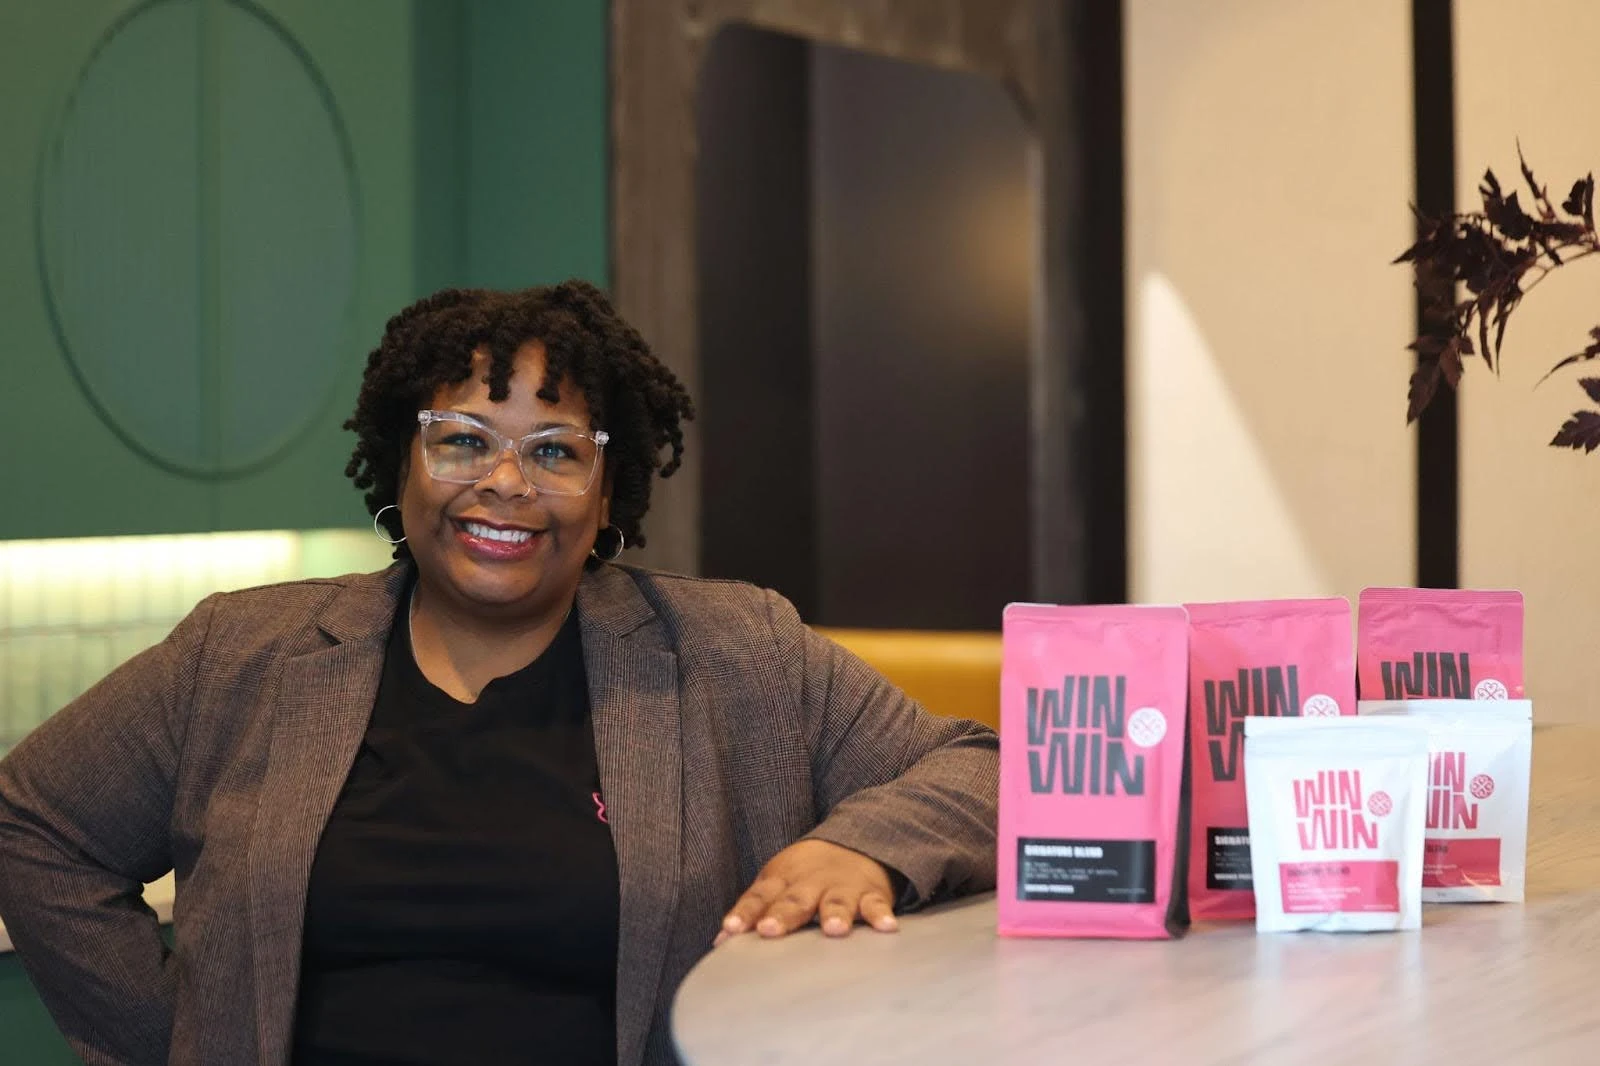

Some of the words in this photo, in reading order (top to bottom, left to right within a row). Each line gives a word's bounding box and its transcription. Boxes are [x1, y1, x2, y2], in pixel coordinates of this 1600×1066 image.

[1381, 652, 1472, 700] WIN
[1027, 675, 1126, 745] WIN
[1204, 665, 1300, 736] WIN
[1027, 732, 1145, 795] WIN
[1427, 752, 1466, 792] IN
[1293, 770, 1362, 818] WIN
[1074, 846, 1103, 859] BLEND
[1297, 808, 1379, 850] WIN
